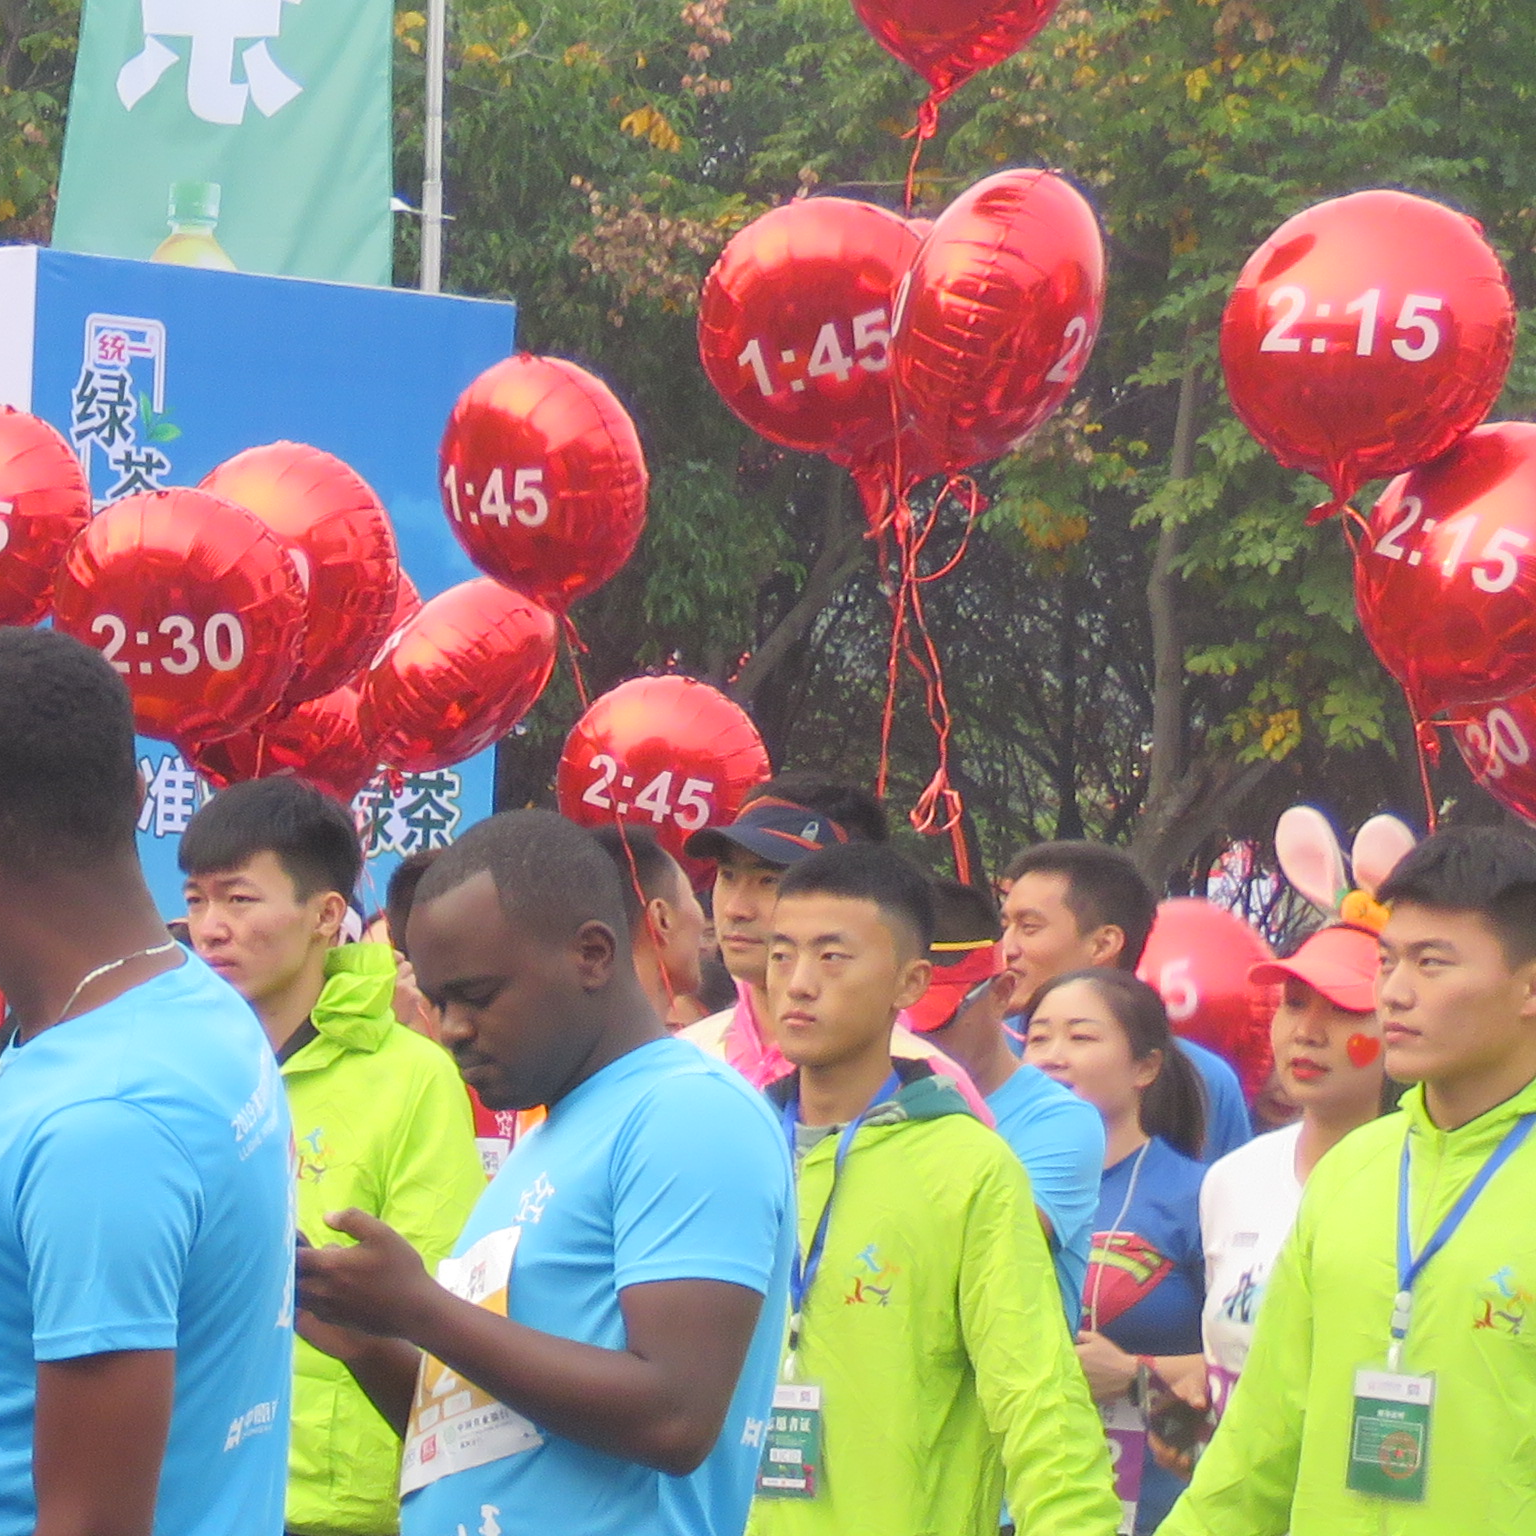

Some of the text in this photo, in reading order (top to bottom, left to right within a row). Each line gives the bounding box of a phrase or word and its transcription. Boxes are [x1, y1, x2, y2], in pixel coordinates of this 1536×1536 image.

[98, 333, 151, 362] 统一
[738, 309, 890, 397] 1:45
[1260, 286, 1444, 362] 2:15
[444, 468, 549, 527] 1:45
[1374, 496, 1530, 593] 2:15
[91, 612, 245, 675] 2:30
[582, 754, 714, 831] 2:45
